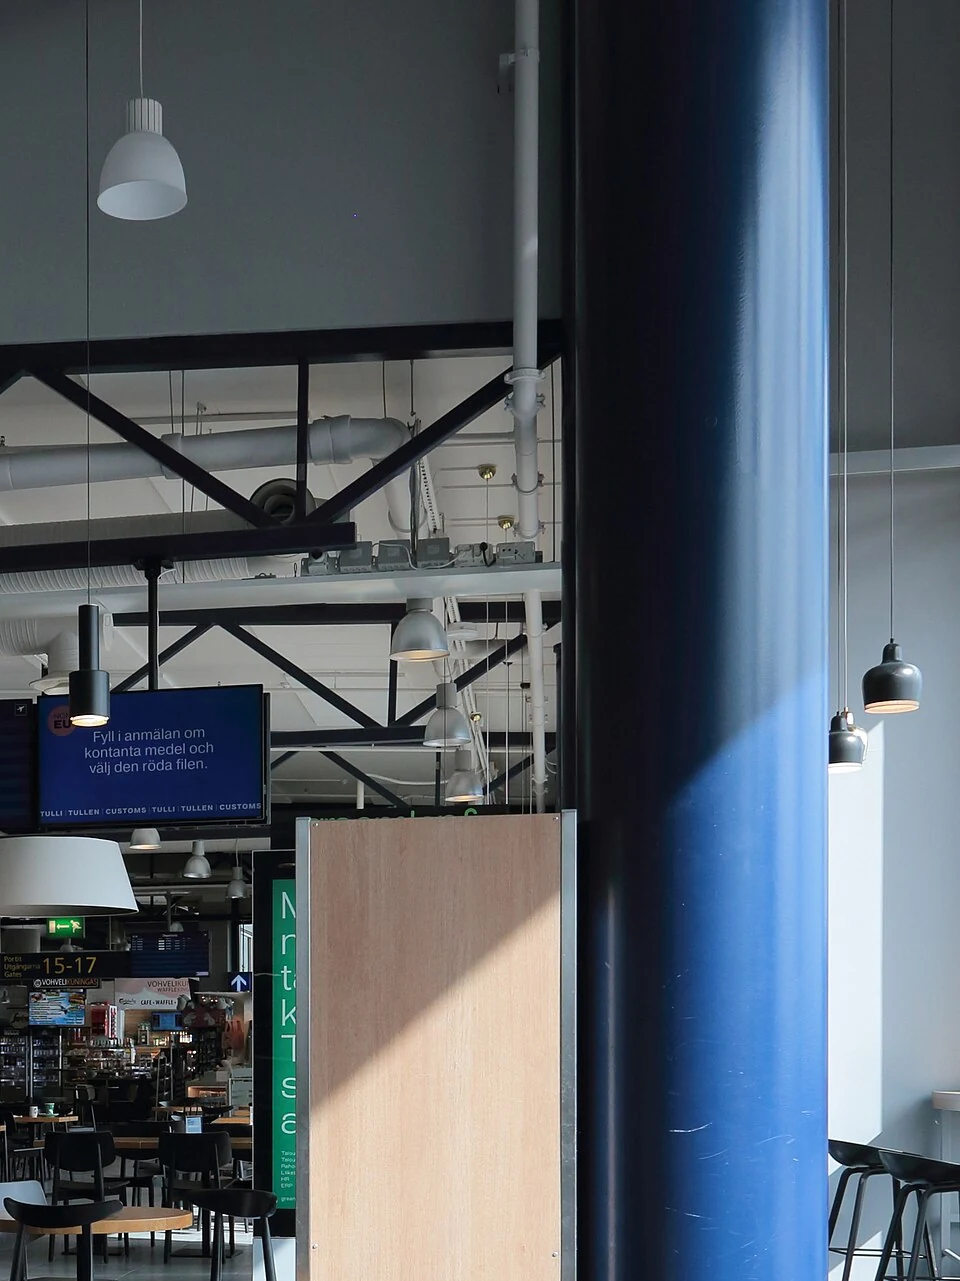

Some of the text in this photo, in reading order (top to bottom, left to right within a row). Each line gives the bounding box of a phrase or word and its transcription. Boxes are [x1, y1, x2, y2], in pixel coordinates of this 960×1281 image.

[53, 719, 71, 729] EU
[93, 730, 115, 745] Fyll
[124, 728, 181, 742] anmälan
[184, 729, 206, 739] om
[84, 742, 214, 760] kontanta medel och
[88, 758, 208, 776] välj den röda filen.
[68, 808, 100, 816] TULLEN
[105, 807, 147, 815] CUSTOMS
[180, 804, 214, 812] TULLEN
[219, 802, 262, 811] CUSTOMS
[43, 956, 97, 974] 15-17
